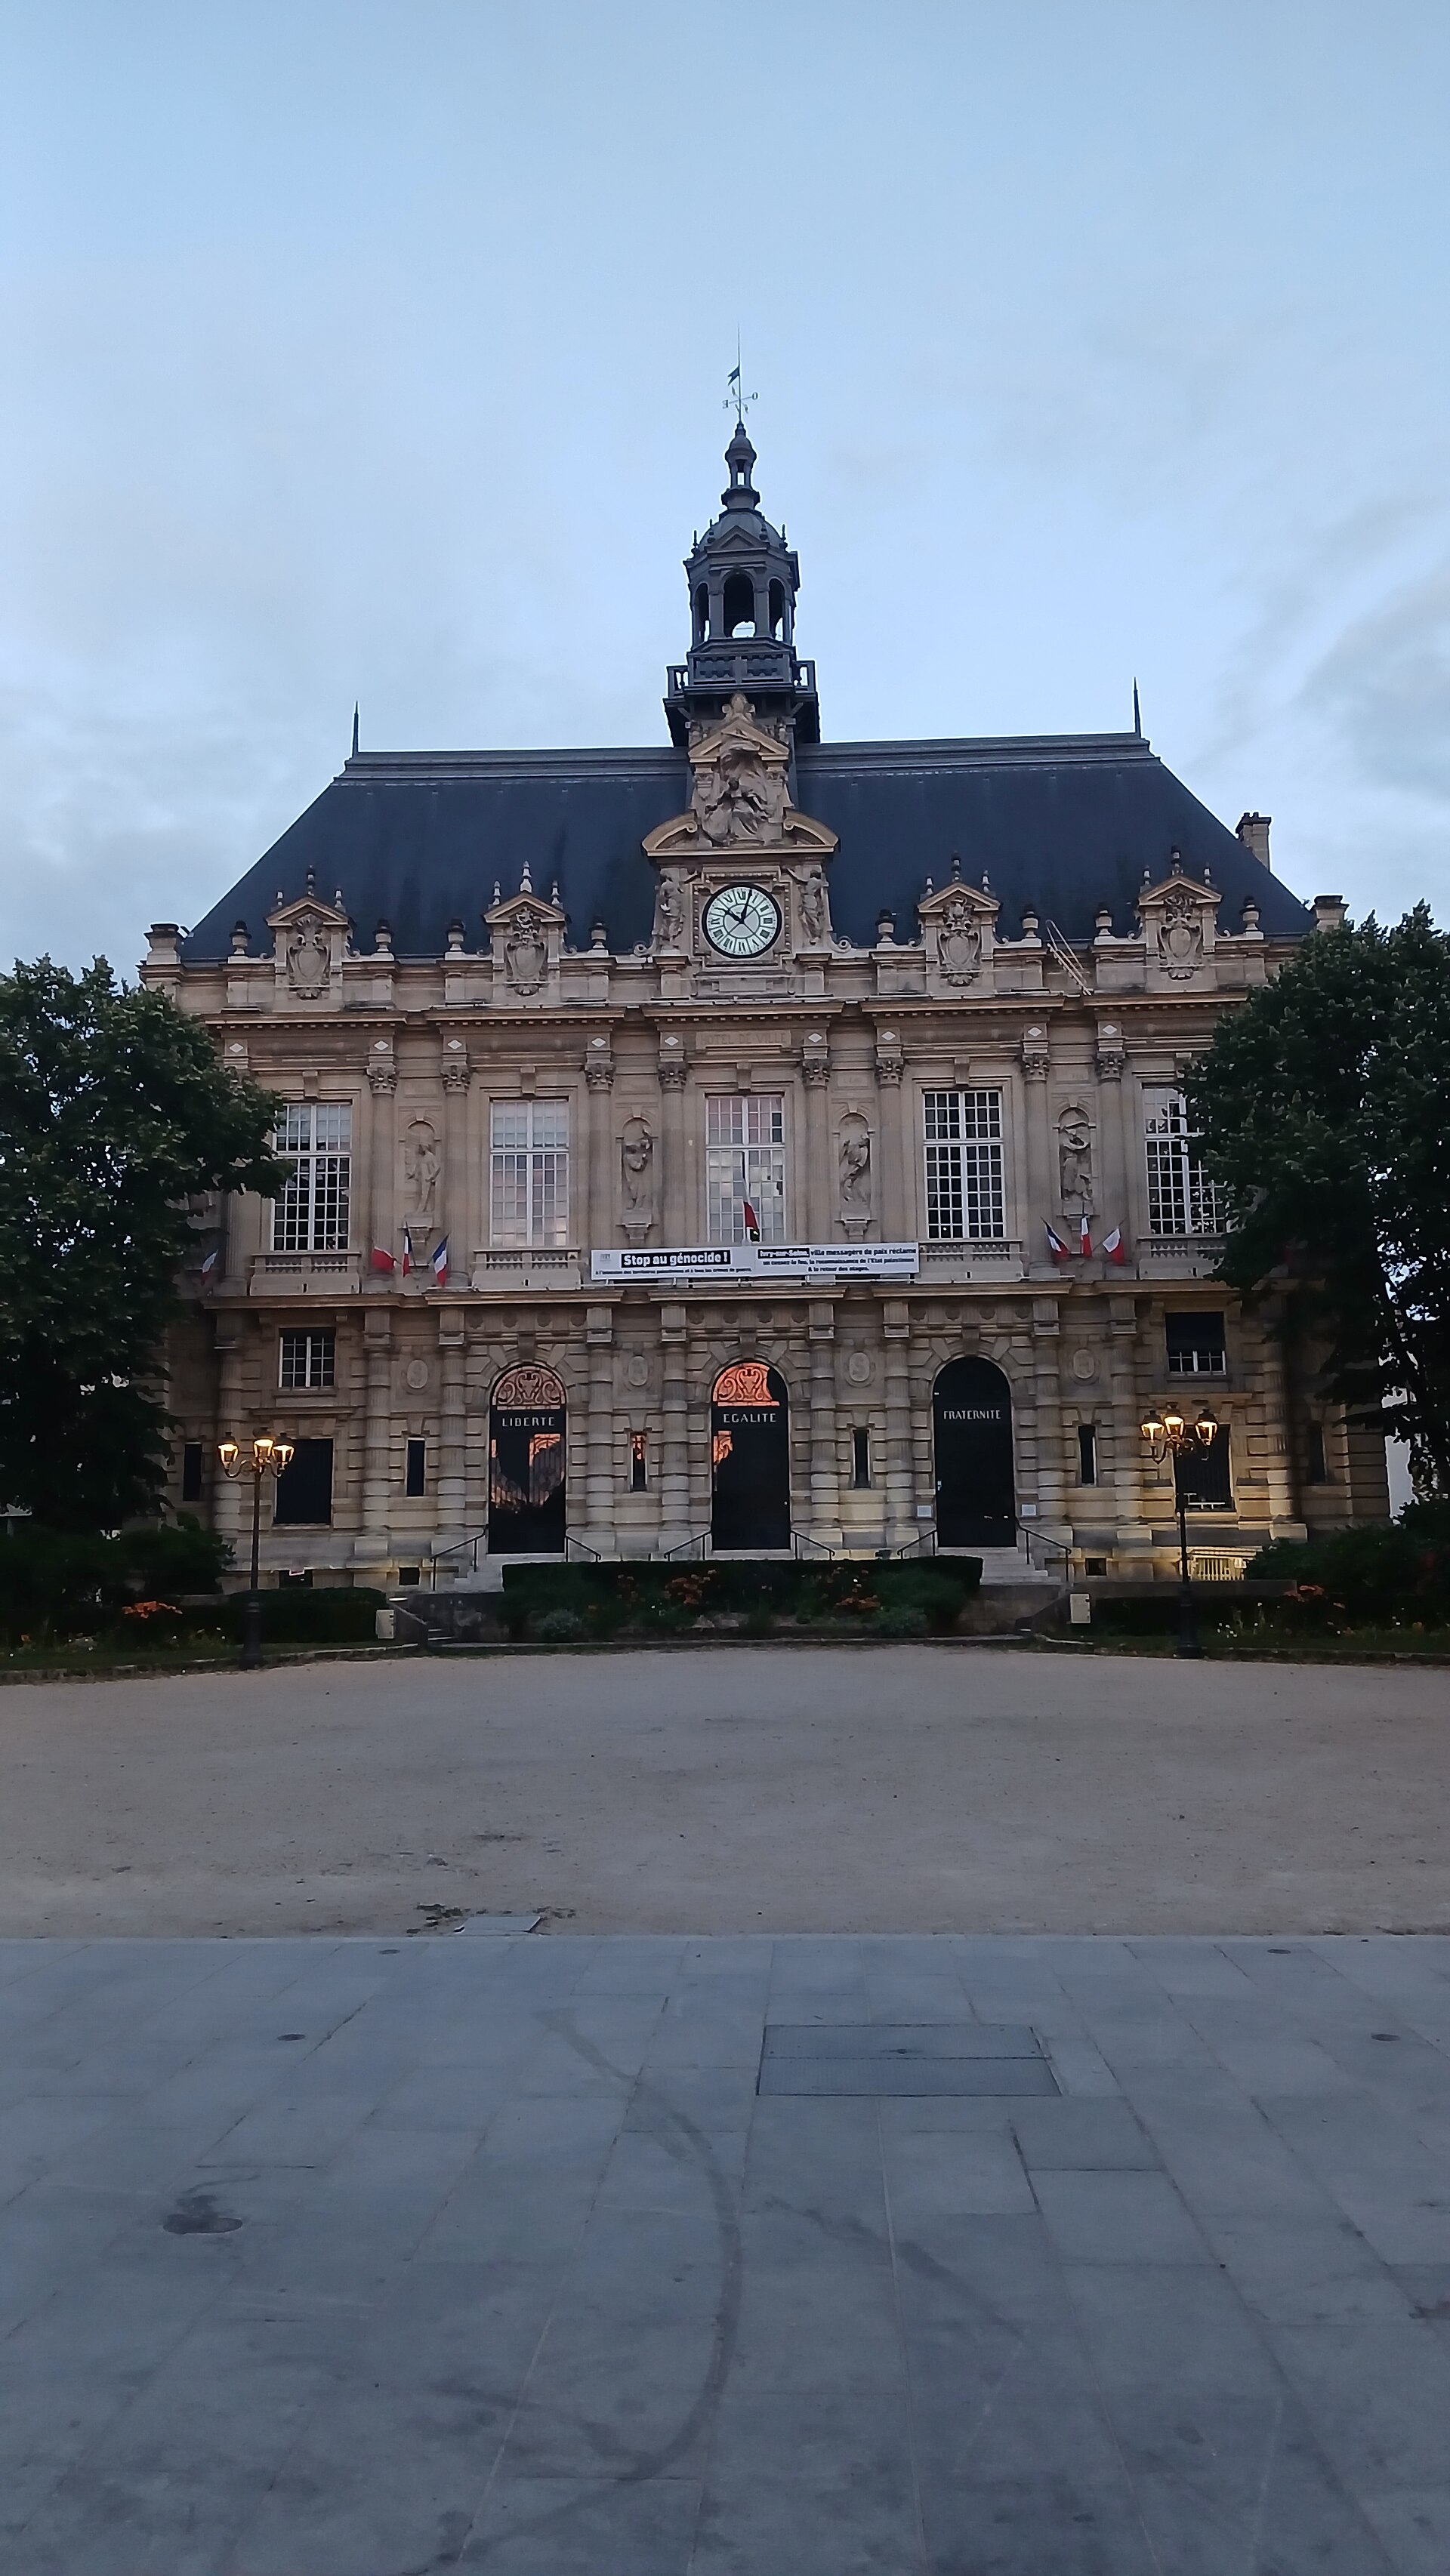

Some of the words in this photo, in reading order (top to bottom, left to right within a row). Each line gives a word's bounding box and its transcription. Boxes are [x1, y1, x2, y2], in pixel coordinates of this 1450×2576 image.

[874, 1248, 887, 1256] paix
[624, 1255, 650, 1267] Stop
[652, 1256, 667, 1264] au
[670, 1252, 721, 1266] génocide
[723, 1251, 728, 1262] !
[723, 1413, 776, 1423] EGALITE
[943, 1410, 1001, 1420] FRATERNITE
[502, 1417, 554, 1427] LIBERTE
